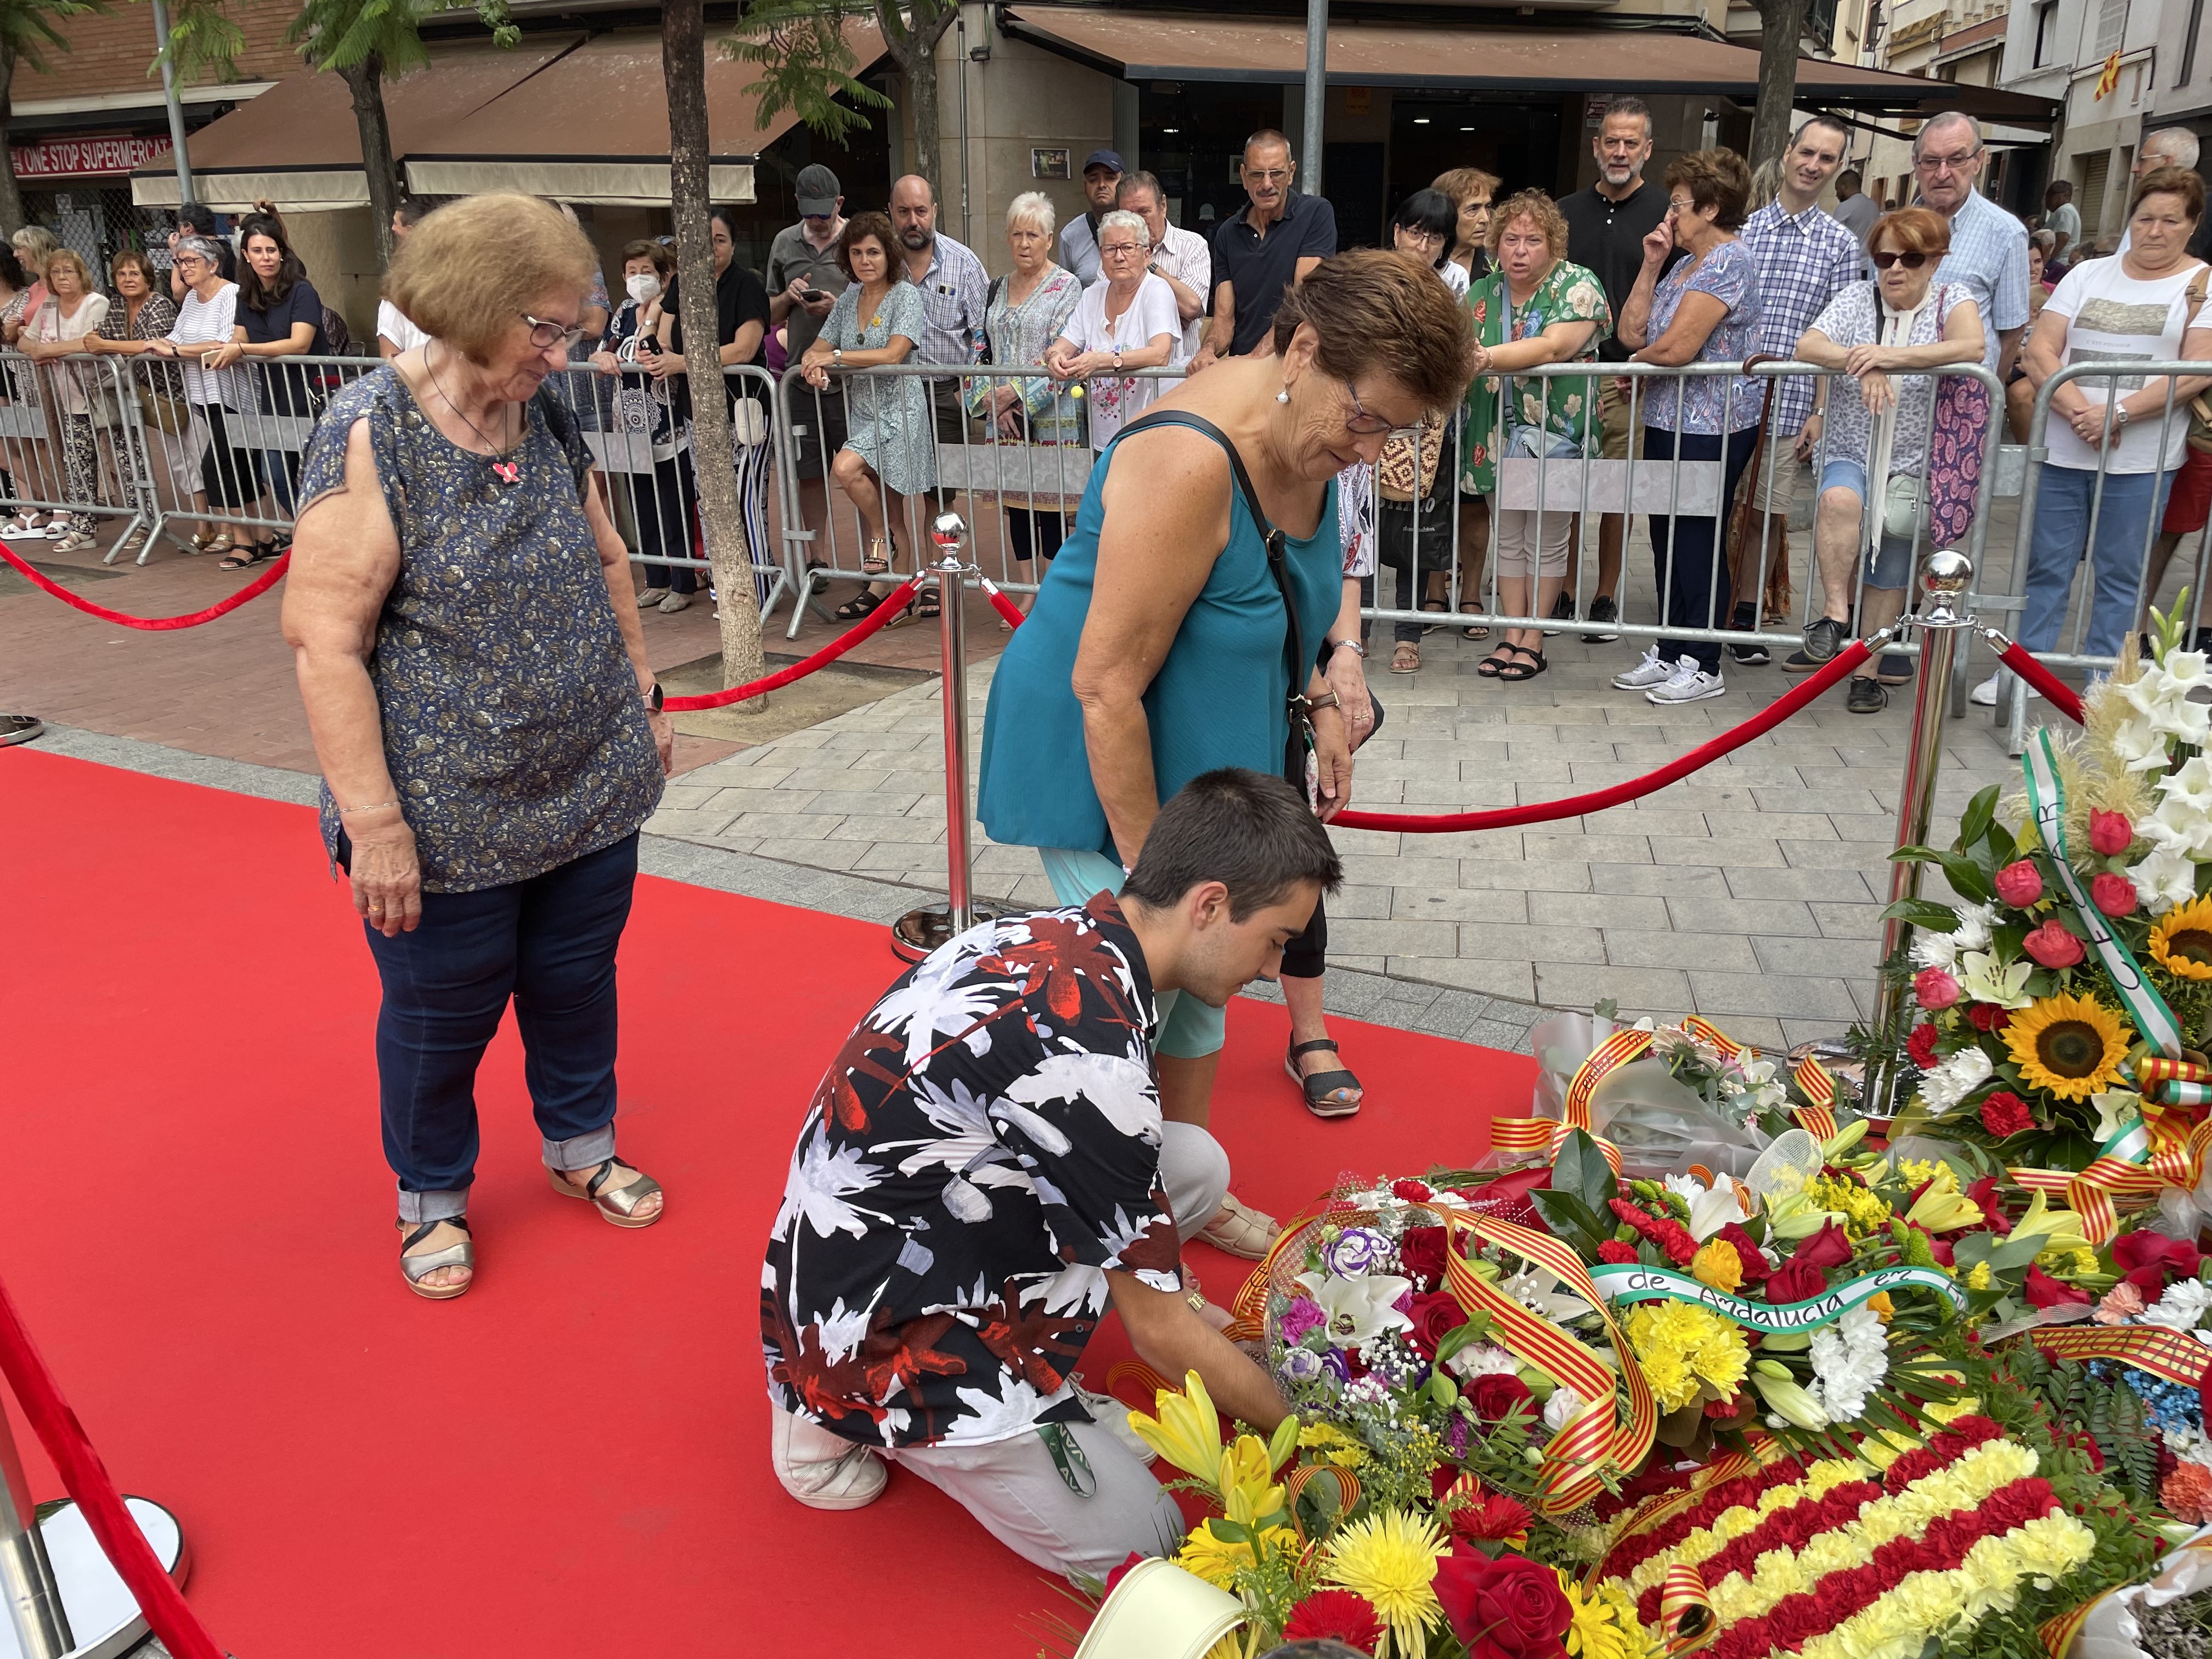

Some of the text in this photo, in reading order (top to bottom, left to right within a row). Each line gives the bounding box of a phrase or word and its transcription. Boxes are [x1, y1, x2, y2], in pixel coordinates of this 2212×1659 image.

[25, 138, 172, 172] ONE STOP SUPERMERCAT
[1627, 1266, 1912, 1329] de Andalucia en
